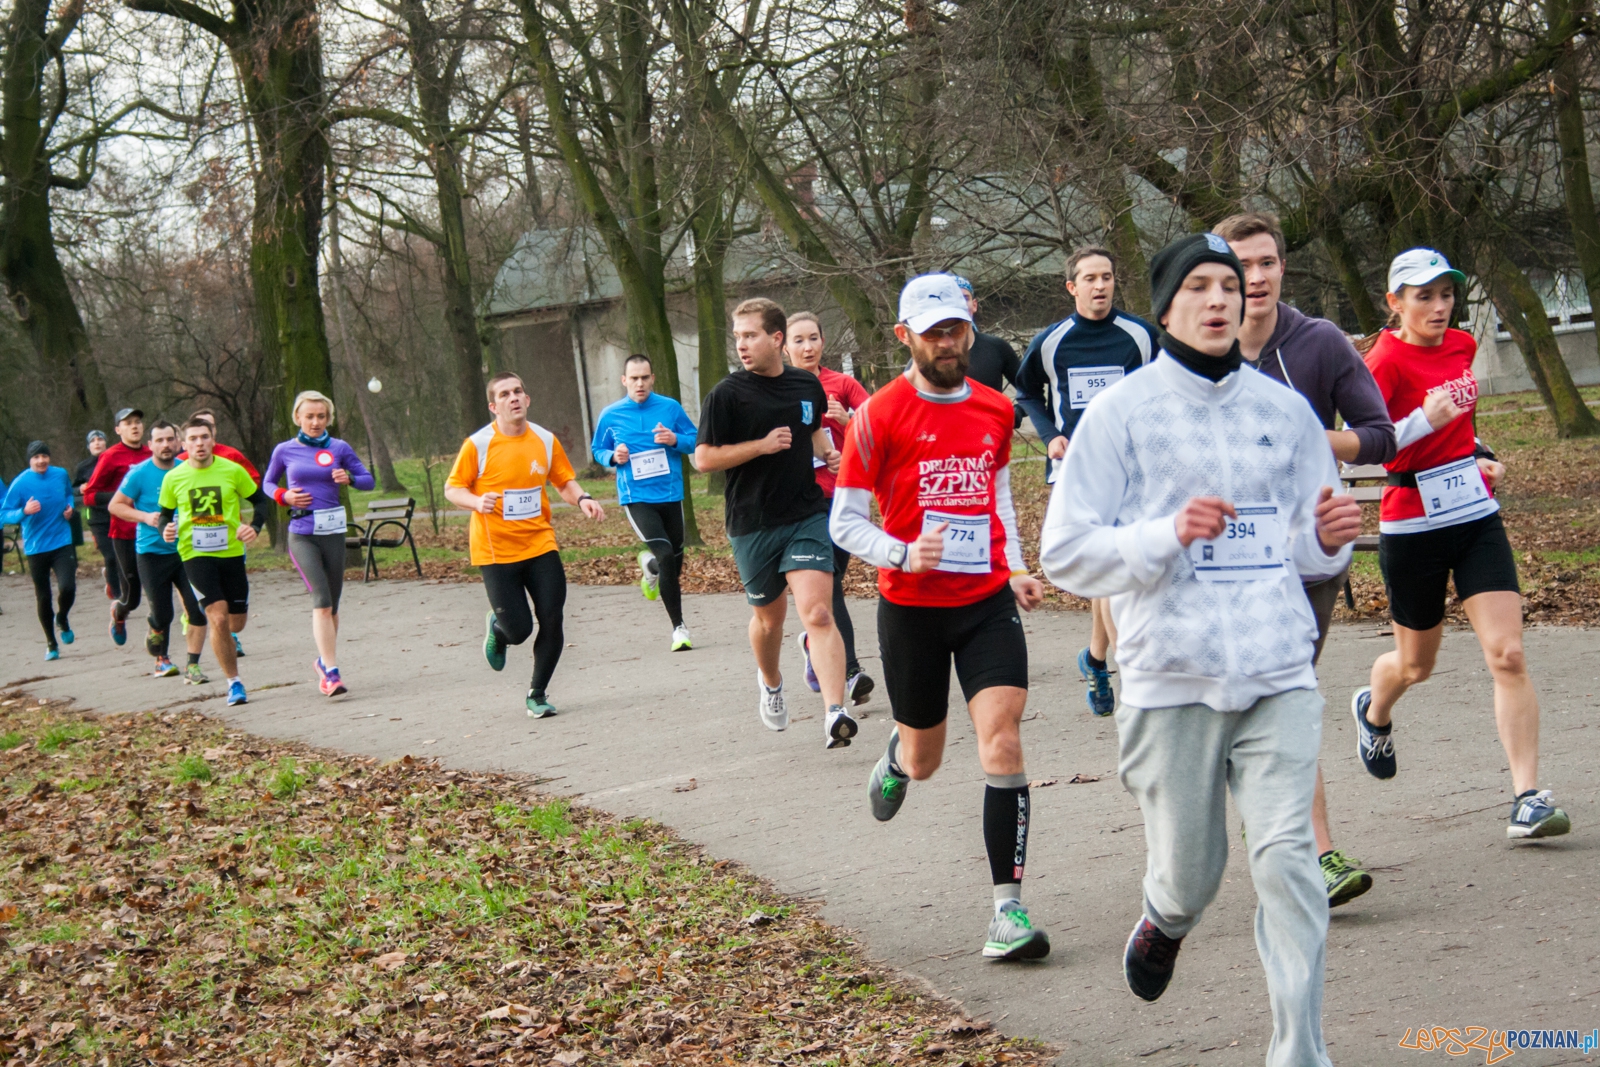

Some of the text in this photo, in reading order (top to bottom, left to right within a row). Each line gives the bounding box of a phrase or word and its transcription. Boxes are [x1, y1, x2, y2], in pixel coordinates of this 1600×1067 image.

[1087, 378, 1106, 388] 955
[642, 457, 655, 466] 947
[918, 454, 985, 475] DRUŻYNA
[1443, 474, 1466, 490] 772
[518, 495, 532, 504] 120
[950, 528, 975, 543] 774
[1227, 522, 1256, 539] 394
